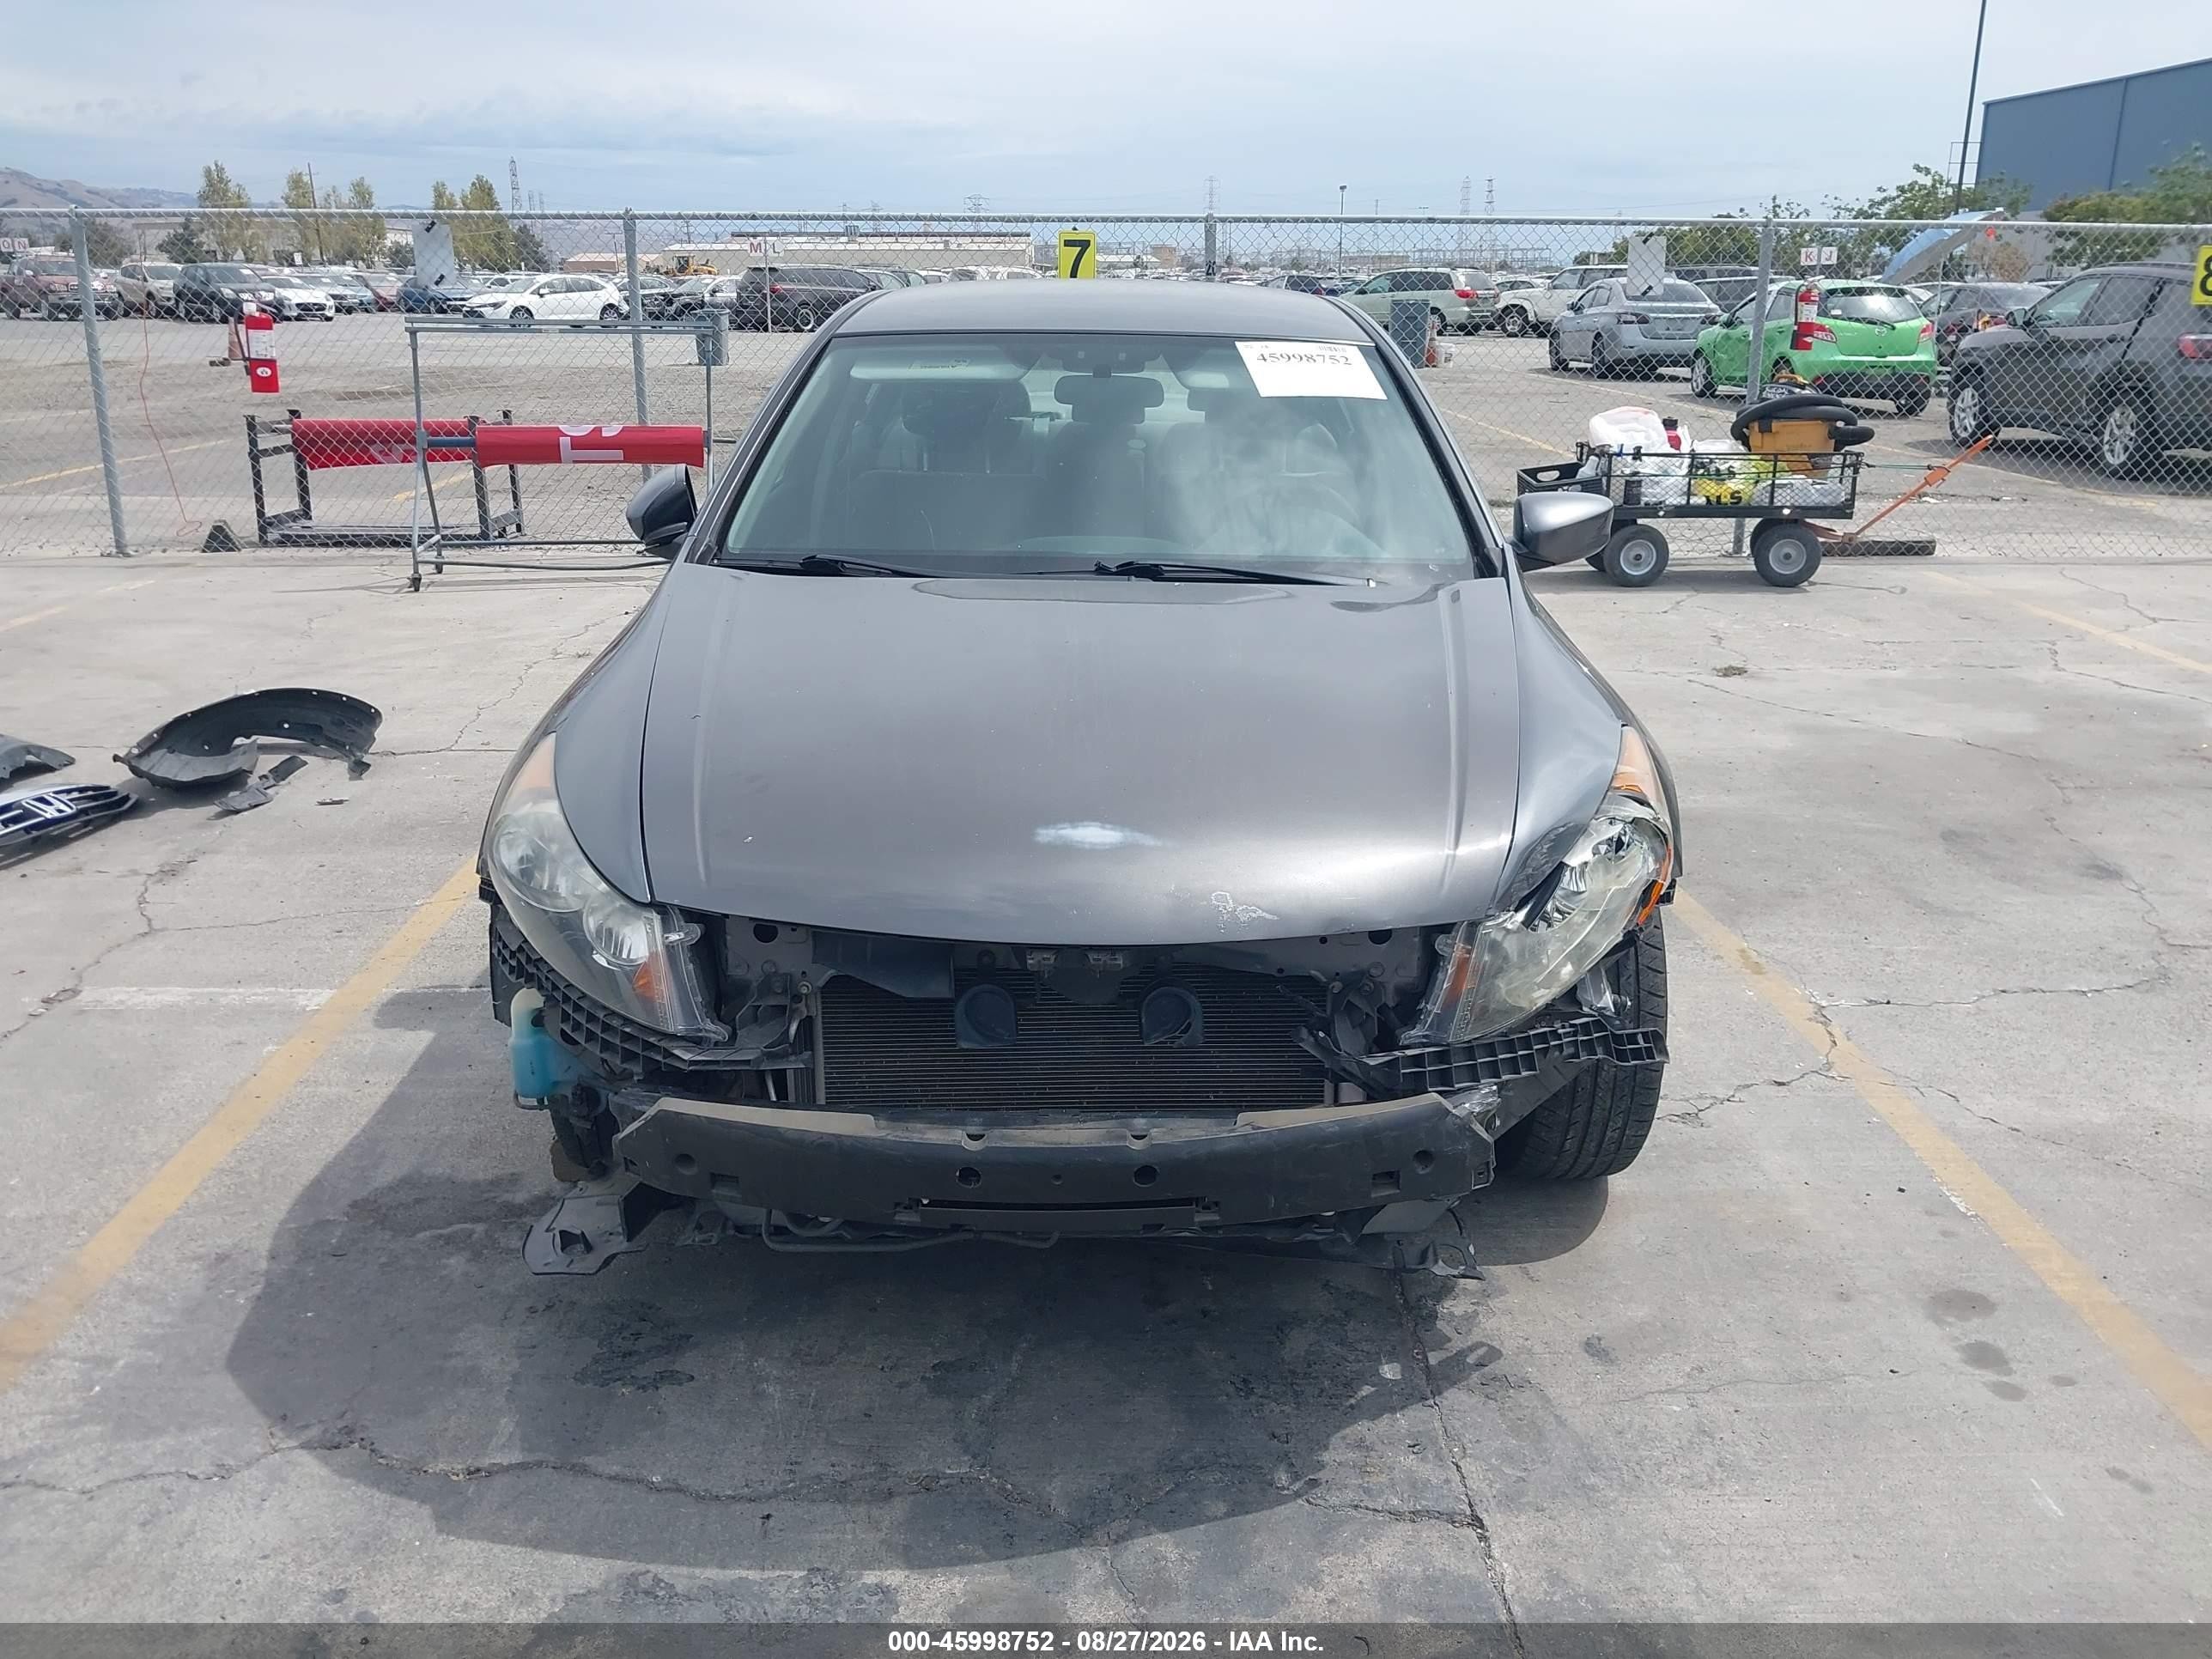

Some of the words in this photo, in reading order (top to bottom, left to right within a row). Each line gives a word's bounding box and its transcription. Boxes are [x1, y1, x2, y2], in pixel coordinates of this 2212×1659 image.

[17, 240, 27, 250] N
[750, 242, 762, 253] M
[1064, 240, 1091, 278] 7
[1805, 251, 1814, 262] K
[1826, 250, 1832, 262] J
[1257, 353, 1352, 365] 45998752
